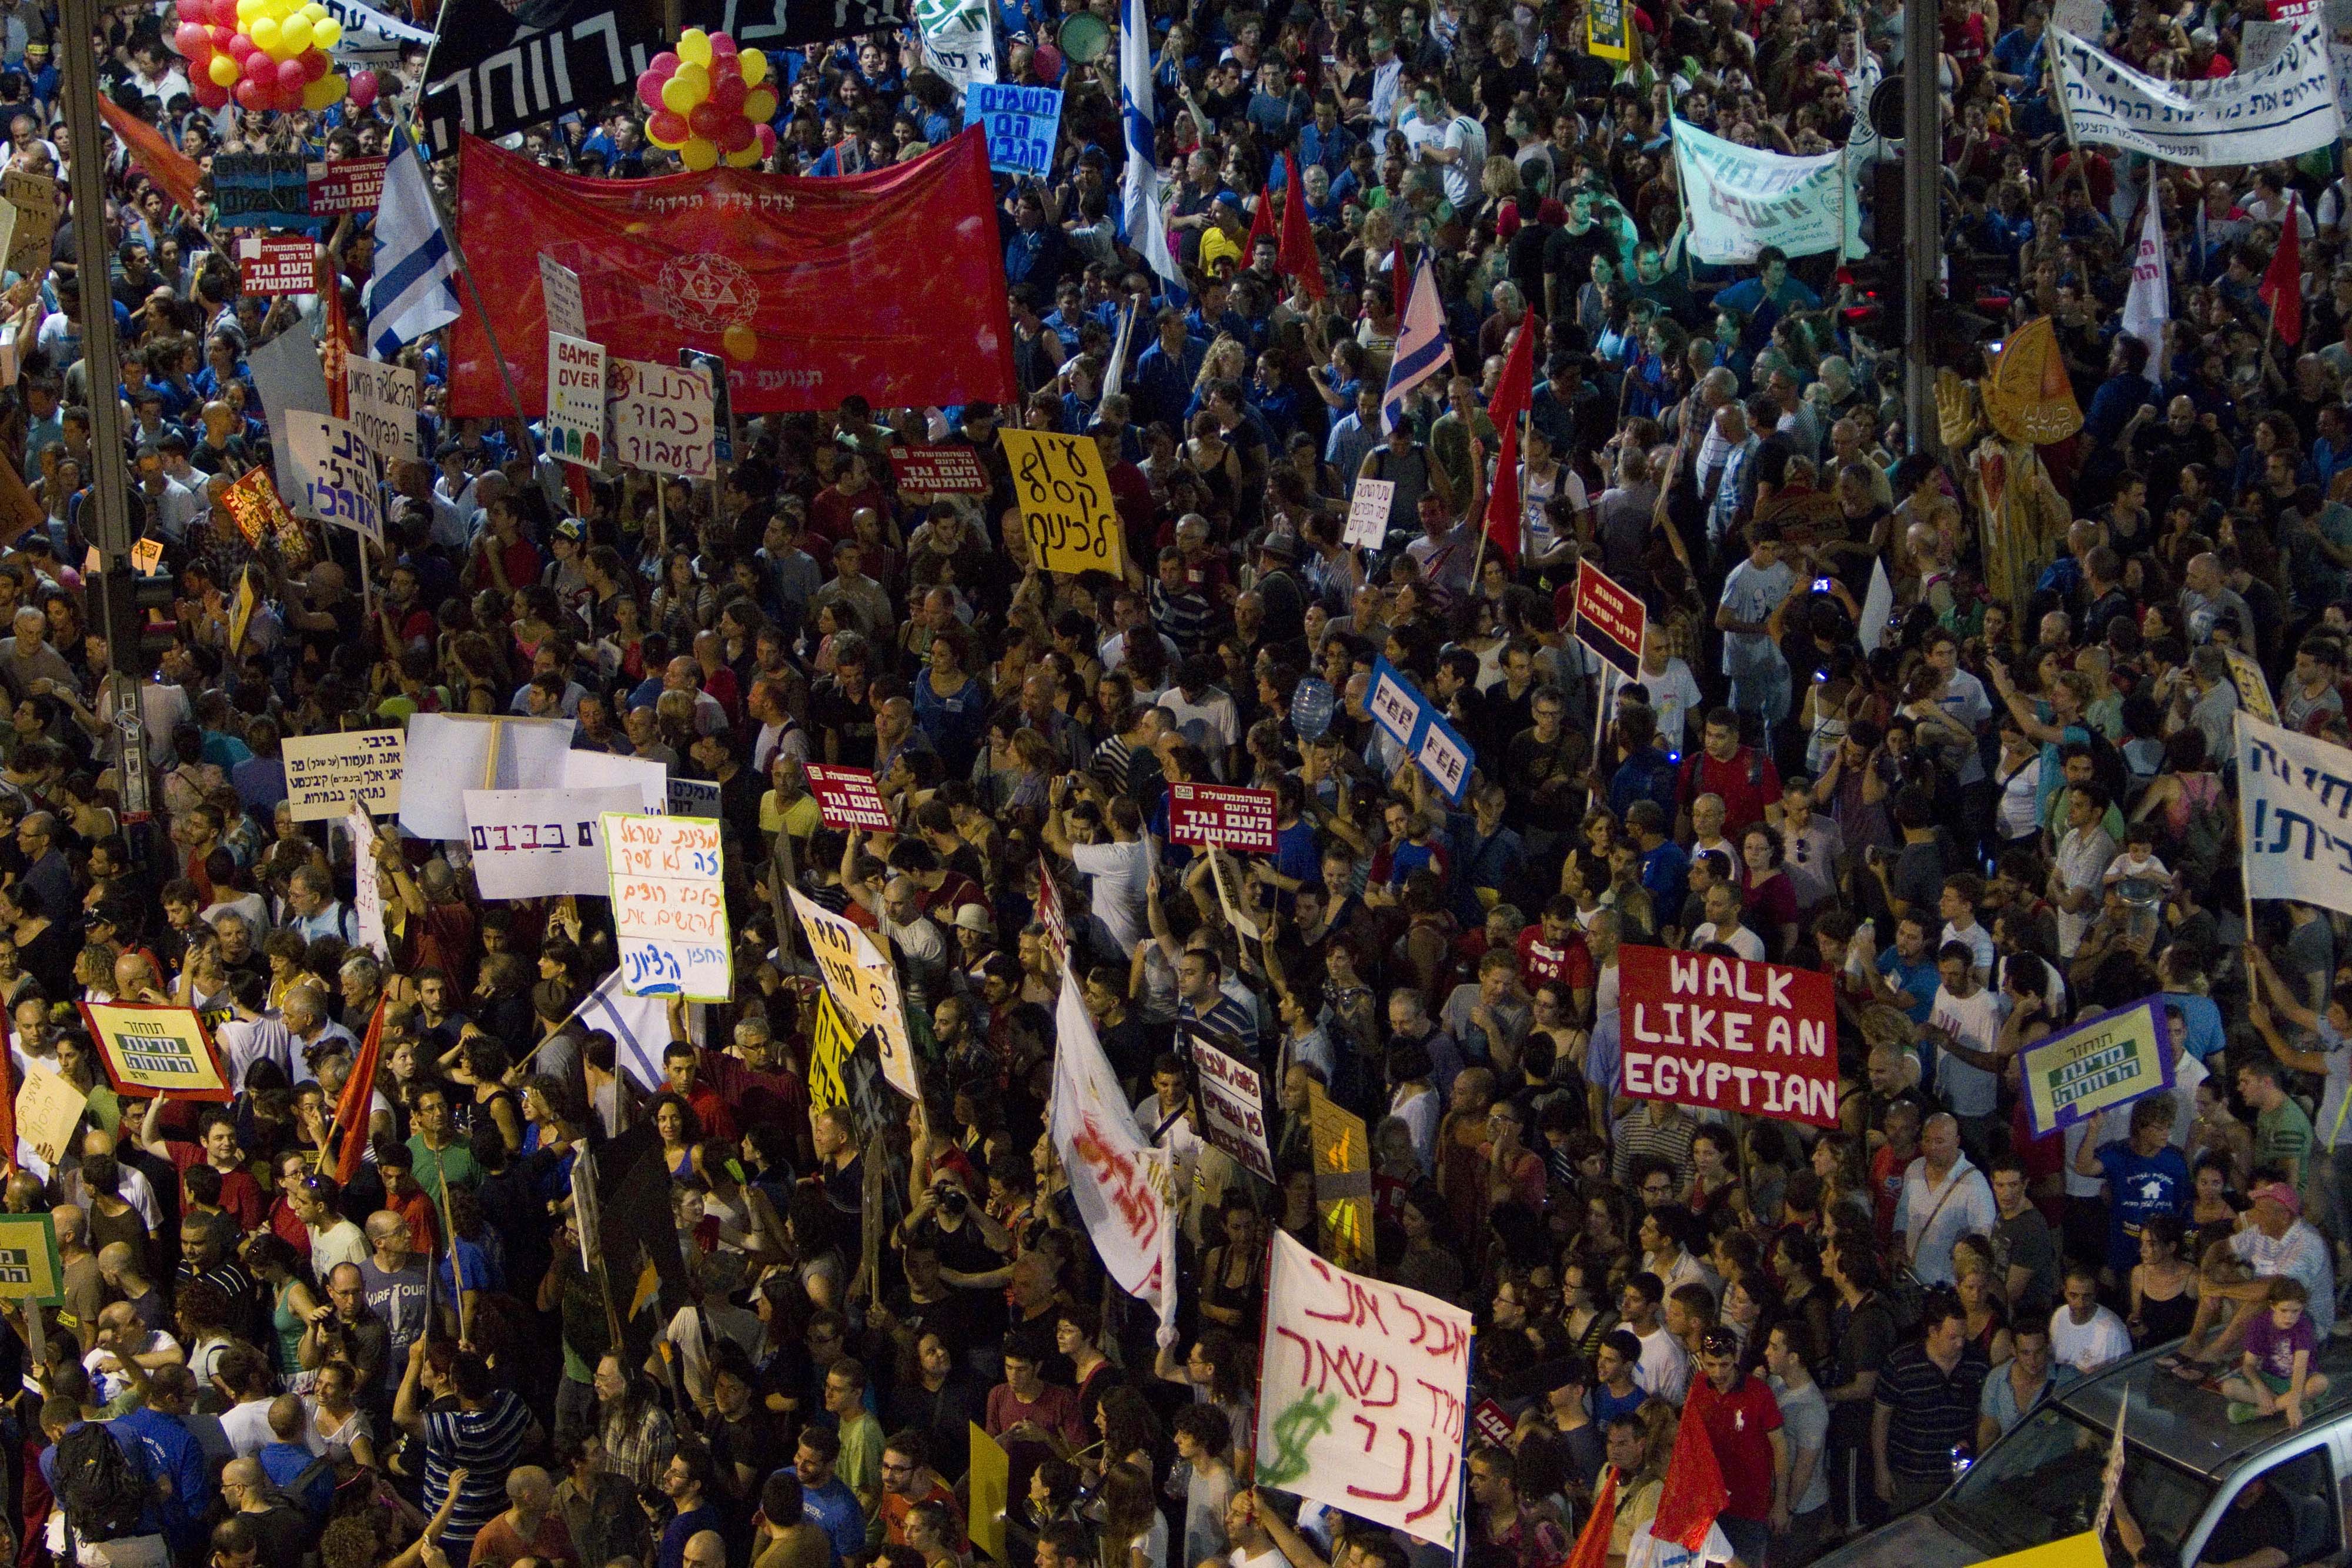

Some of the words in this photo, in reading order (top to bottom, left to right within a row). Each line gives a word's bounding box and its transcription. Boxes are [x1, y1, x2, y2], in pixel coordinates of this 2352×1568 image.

[981, 88, 1057, 115] השמים
[2250, 88, 2278, 116] את
[995, 113, 1031, 140] הם
[2073, 121, 2110, 135] הצעי
[990, 136, 1048, 169] הגבו
[2157, 143, 2201, 159] תנועת
[319, 183, 346, 196] נגד
[262, 243, 312, 253] כשהממשלה
[250, 263, 275, 276] נגד
[280, 262, 313, 275] העם
[245, 277, 313, 291] הממשלה
[559, 342, 600, 369] GAME
[559, 369, 600, 390] OVER
[639, 371, 696, 401] תנו
[757, 370, 823, 390] תנועת
[633, 403, 699, 435] כבוד
[628, 436, 703, 469] לעבוד
[319, 458, 344, 489] לי
[903, 466, 934, 477] נגד
[939, 466, 979, 476] העם
[901, 475, 984, 489] הממשלה
[306, 476, 380, 537] אוהל!
[359, 735, 399, 751] ביבי,
[291, 760, 305, 771] מה
[340, 754, 375, 768] תעמוד
[379, 752, 400, 764] אתה
[363, 769, 385, 785] אלך
[825, 771, 874, 784] כשהממשלה
[350, 786, 386, 800] נתראה
[673, 783, 719, 801] אמנים
[844, 783, 863, 793] העם
[862, 785, 878, 794] נגד
[1201, 791, 1272, 805] כשהממשלה
[667, 799, 694, 814] דור
[821, 791, 848, 807] נגד
[849, 794, 884, 810] העם
[1224, 803, 1250, 813] העם
[822, 805, 890, 826] הממשלה
[1183, 810, 1218, 825] נגד
[1252, 805, 1272, 815] נגד
[620, 817, 663, 847] ישראל
[1226, 813, 1272, 831] העם
[577, 821, 597, 847] ים
[671, 825, 720, 850] מדינת
[1175, 823, 1272, 847] הממשלה
[622, 847, 653, 875] עסק
[663, 845, 682, 871] לא
[693, 850, 720, 876] זה
[623, 882, 667, 904] רוצים
[620, 908, 647, 925] את
[624, 942, 681, 984] הציוני
[1671, 955, 1793, 1009] WALK
[123, 1021, 166, 1035] תוחזר
[1634, 1002, 1754, 1052] LIKE
[1766, 1015, 1825, 1058] AN
[122, 1035, 179, 1054] מדינת
[2066, 1032, 2114, 1059] תוחזר
[124, 1054, 198, 1074] הרווחה!
[2060, 1044, 2126, 1084] מדינת
[1625, 1051, 1836, 1119] EGYPTIAN
[2053, 1058, 2140, 1107] הרווחה!
[1305, 1258, 1389, 1336] אני
[1394, 1292, 1468, 1374] אבל
[1277, 1326, 1399, 1407] נשאר
[1417, 1378, 1465, 1445] תמיד
[1347, 1414, 1455, 1524] עני
